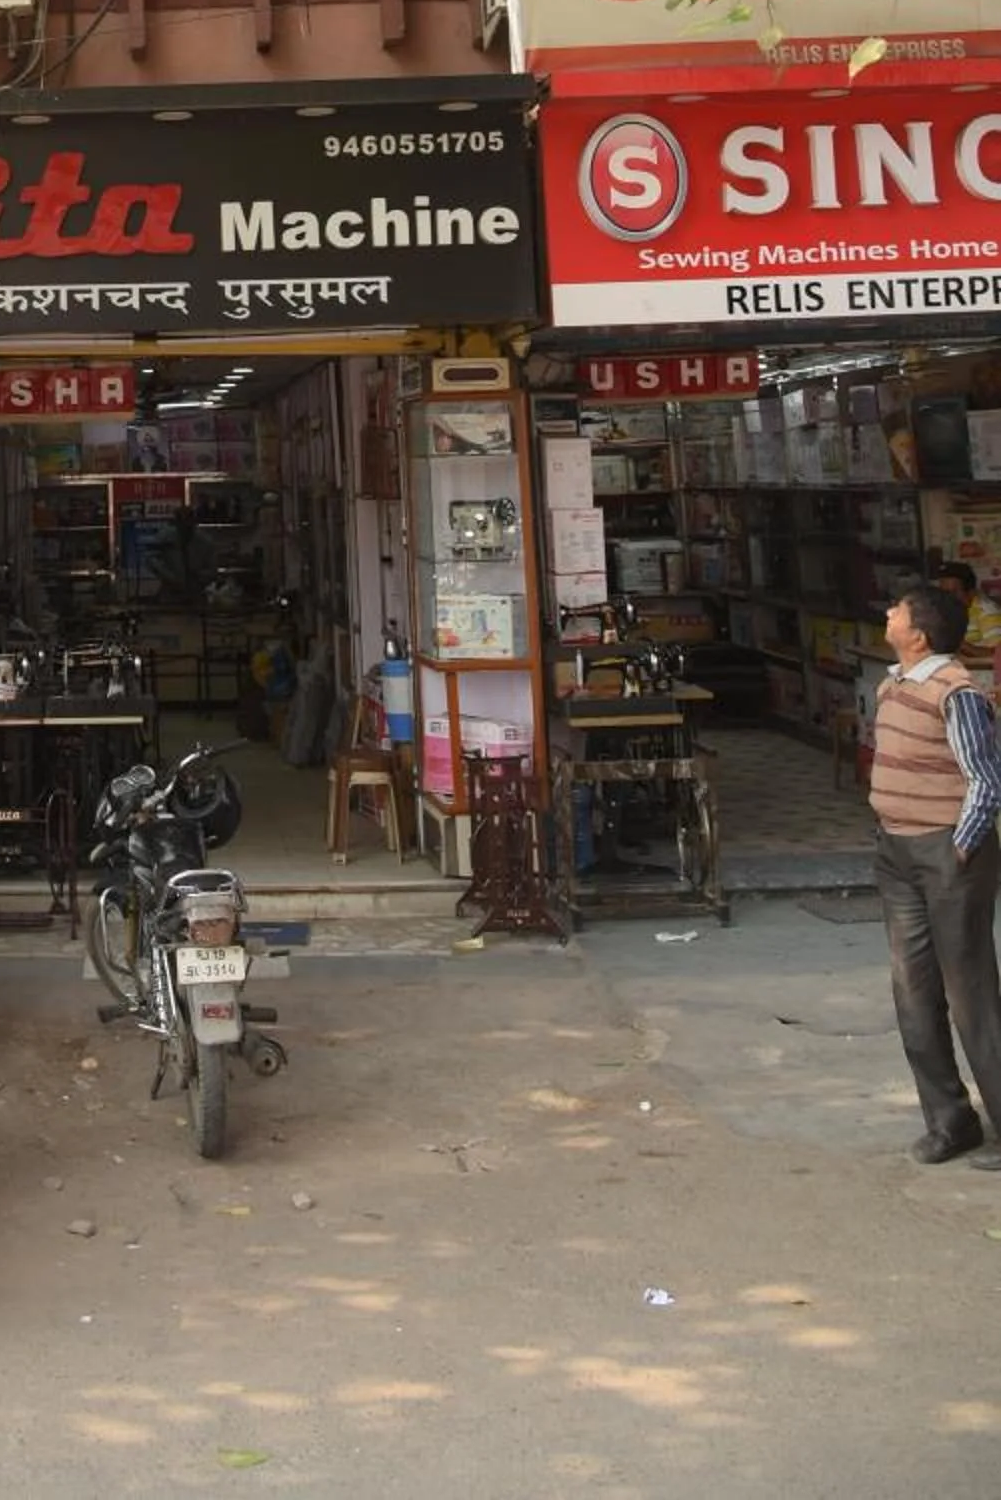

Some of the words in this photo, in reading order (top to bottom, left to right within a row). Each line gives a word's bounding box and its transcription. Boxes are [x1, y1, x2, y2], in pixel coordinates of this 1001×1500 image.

[324, 131, 505, 157] 9460551705
[608, 146, 663, 209] S
[219, 195, 521, 253] Machine
[638, 246, 750, 273] Sewing
[758, 241, 899, 267] Machines
[910, 238, 999, 260] Home
[217, 275, 392, 319] पुरसुमल
[726, 281, 824, 315] RELIS
[589, 356, 750, 393] USHA
